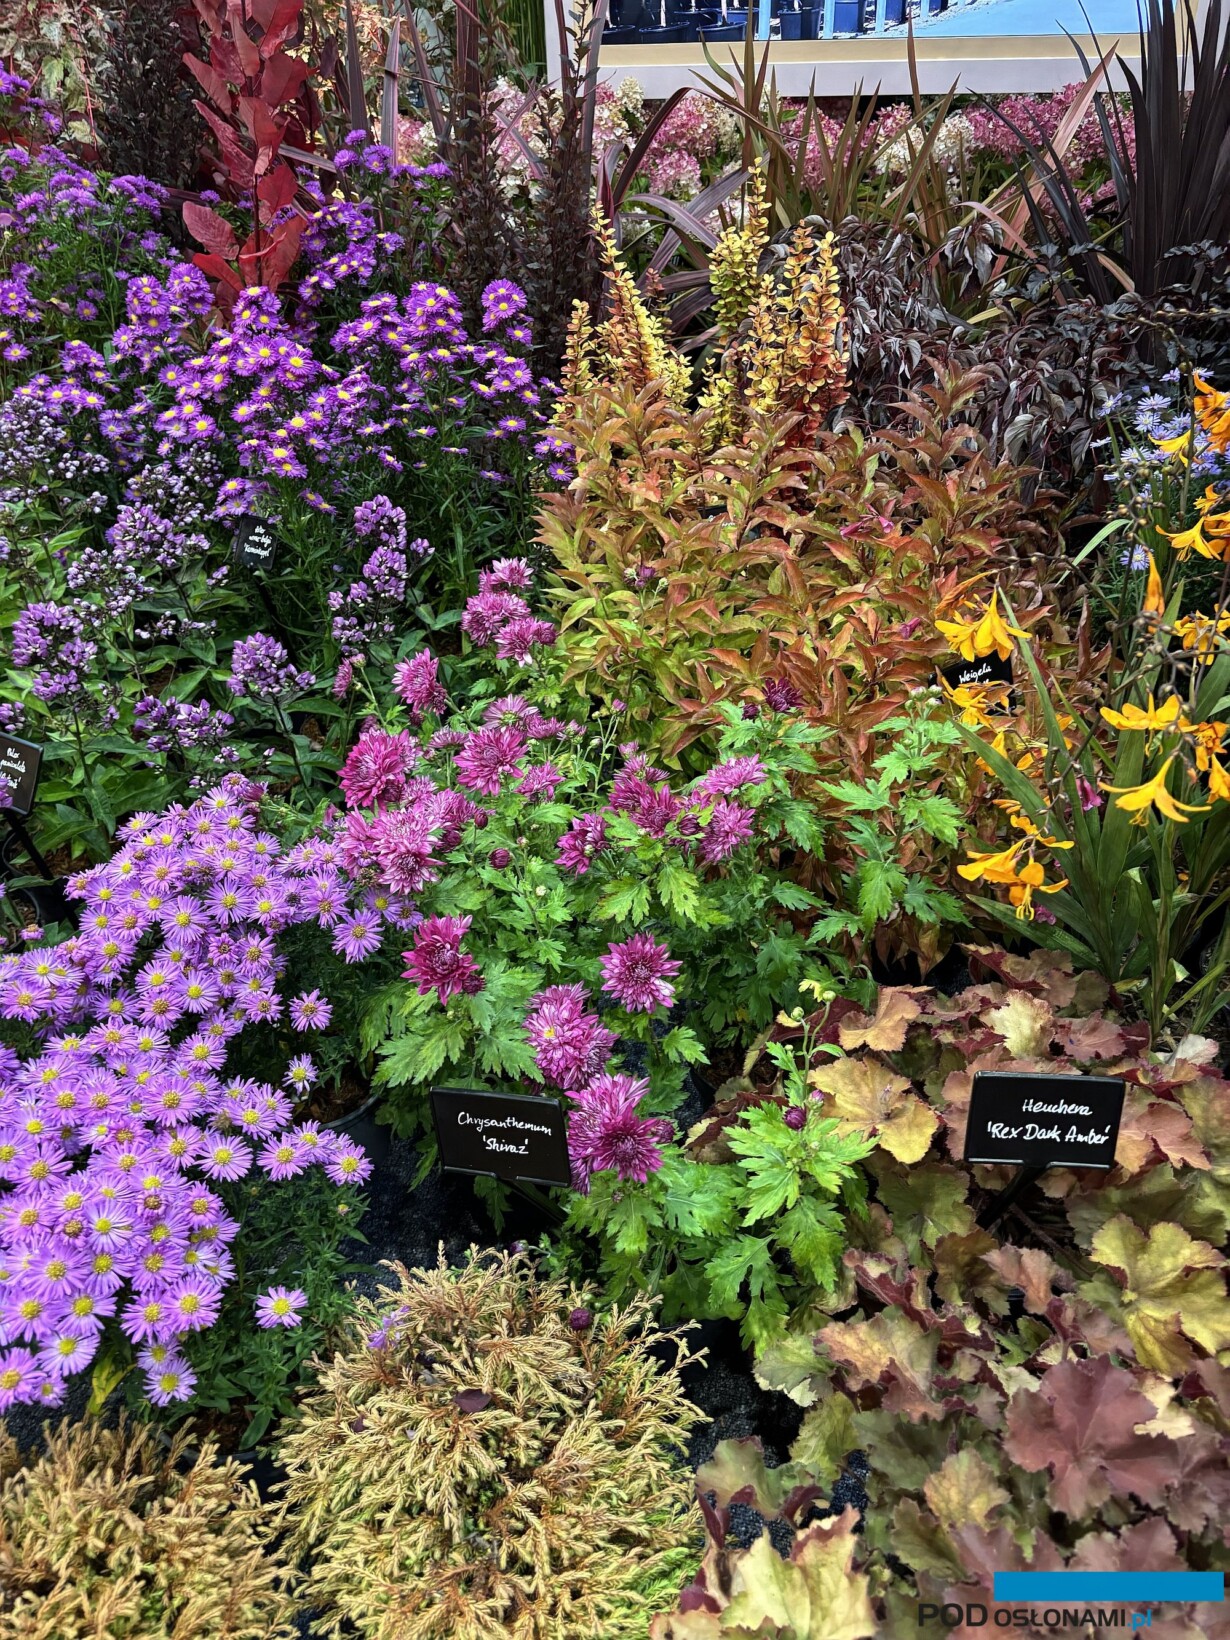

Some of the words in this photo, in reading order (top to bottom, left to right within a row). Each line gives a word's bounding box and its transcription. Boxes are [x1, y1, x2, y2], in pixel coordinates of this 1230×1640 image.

[958, 662, 992, 684] Weigela
[1022, 1098, 1093, 1116] Heuchera
[457, 1111, 552, 1136] Chrysanthemum
[1023, 1123, 1061, 1142] Dark
